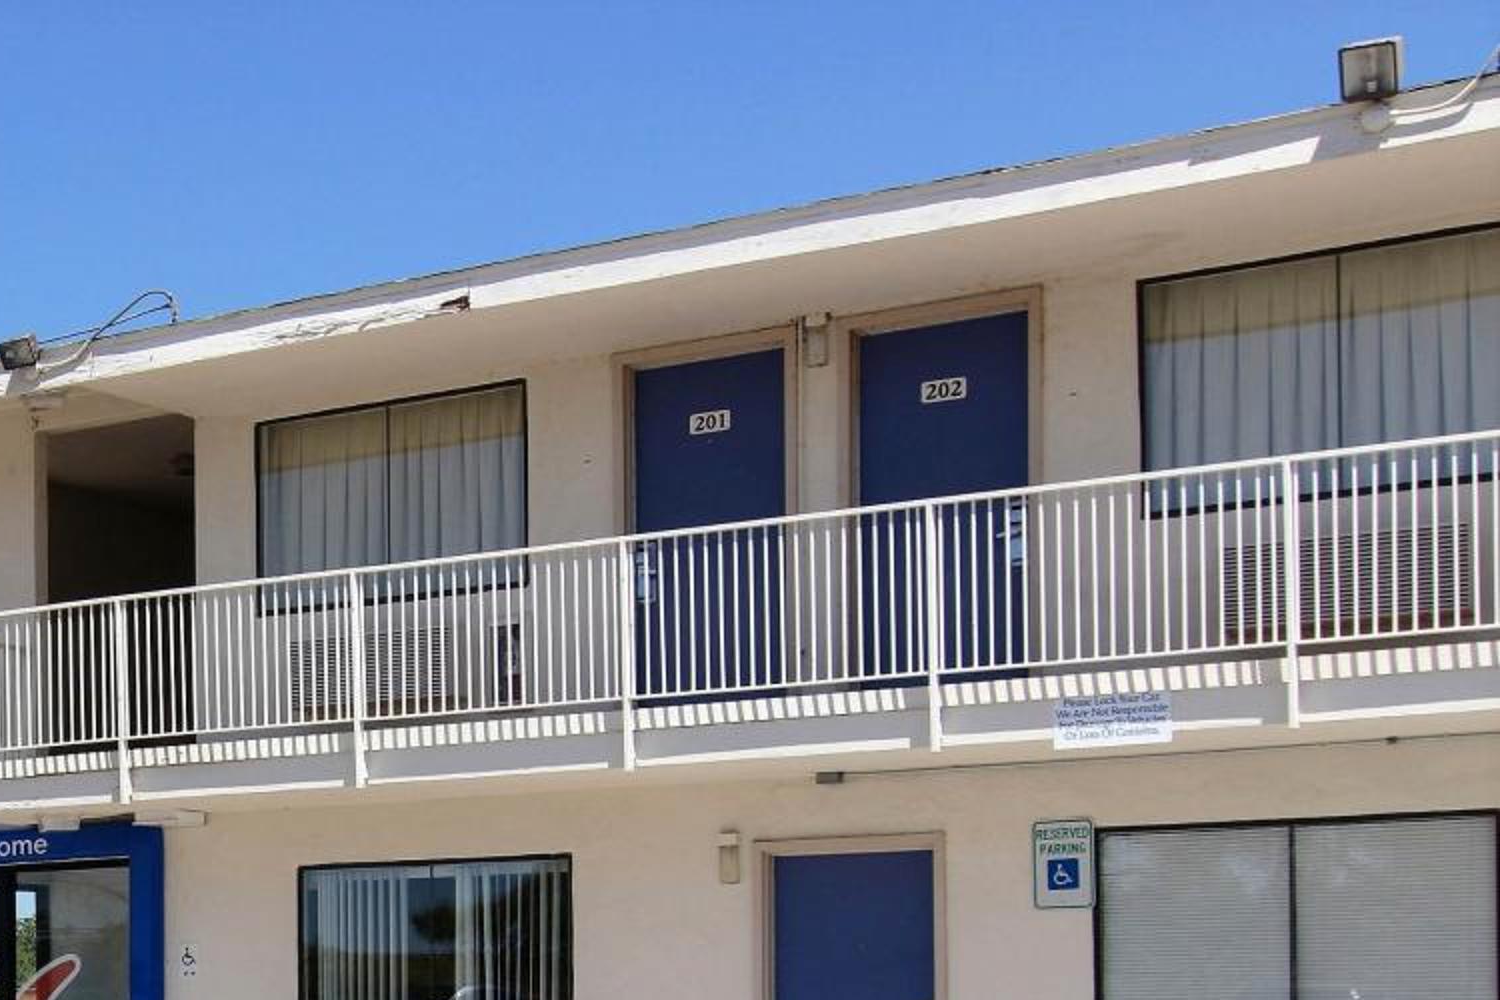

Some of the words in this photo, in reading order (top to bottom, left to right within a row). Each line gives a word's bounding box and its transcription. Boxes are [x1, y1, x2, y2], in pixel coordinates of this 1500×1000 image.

[925, 380, 963, 400] 202
[694, 413, 728, 432] 201
[1093, 694, 1117, 705] Lock
[1056, 709, 1071, 719] We
[1073, 709, 1090, 718] Are
[1091, 707, 1110, 717] Not
[1111, 703, 1169, 716] Responsible
[1036, 827, 1090, 840] RESERVED
[1040, 842, 1087, 854] PARKING
